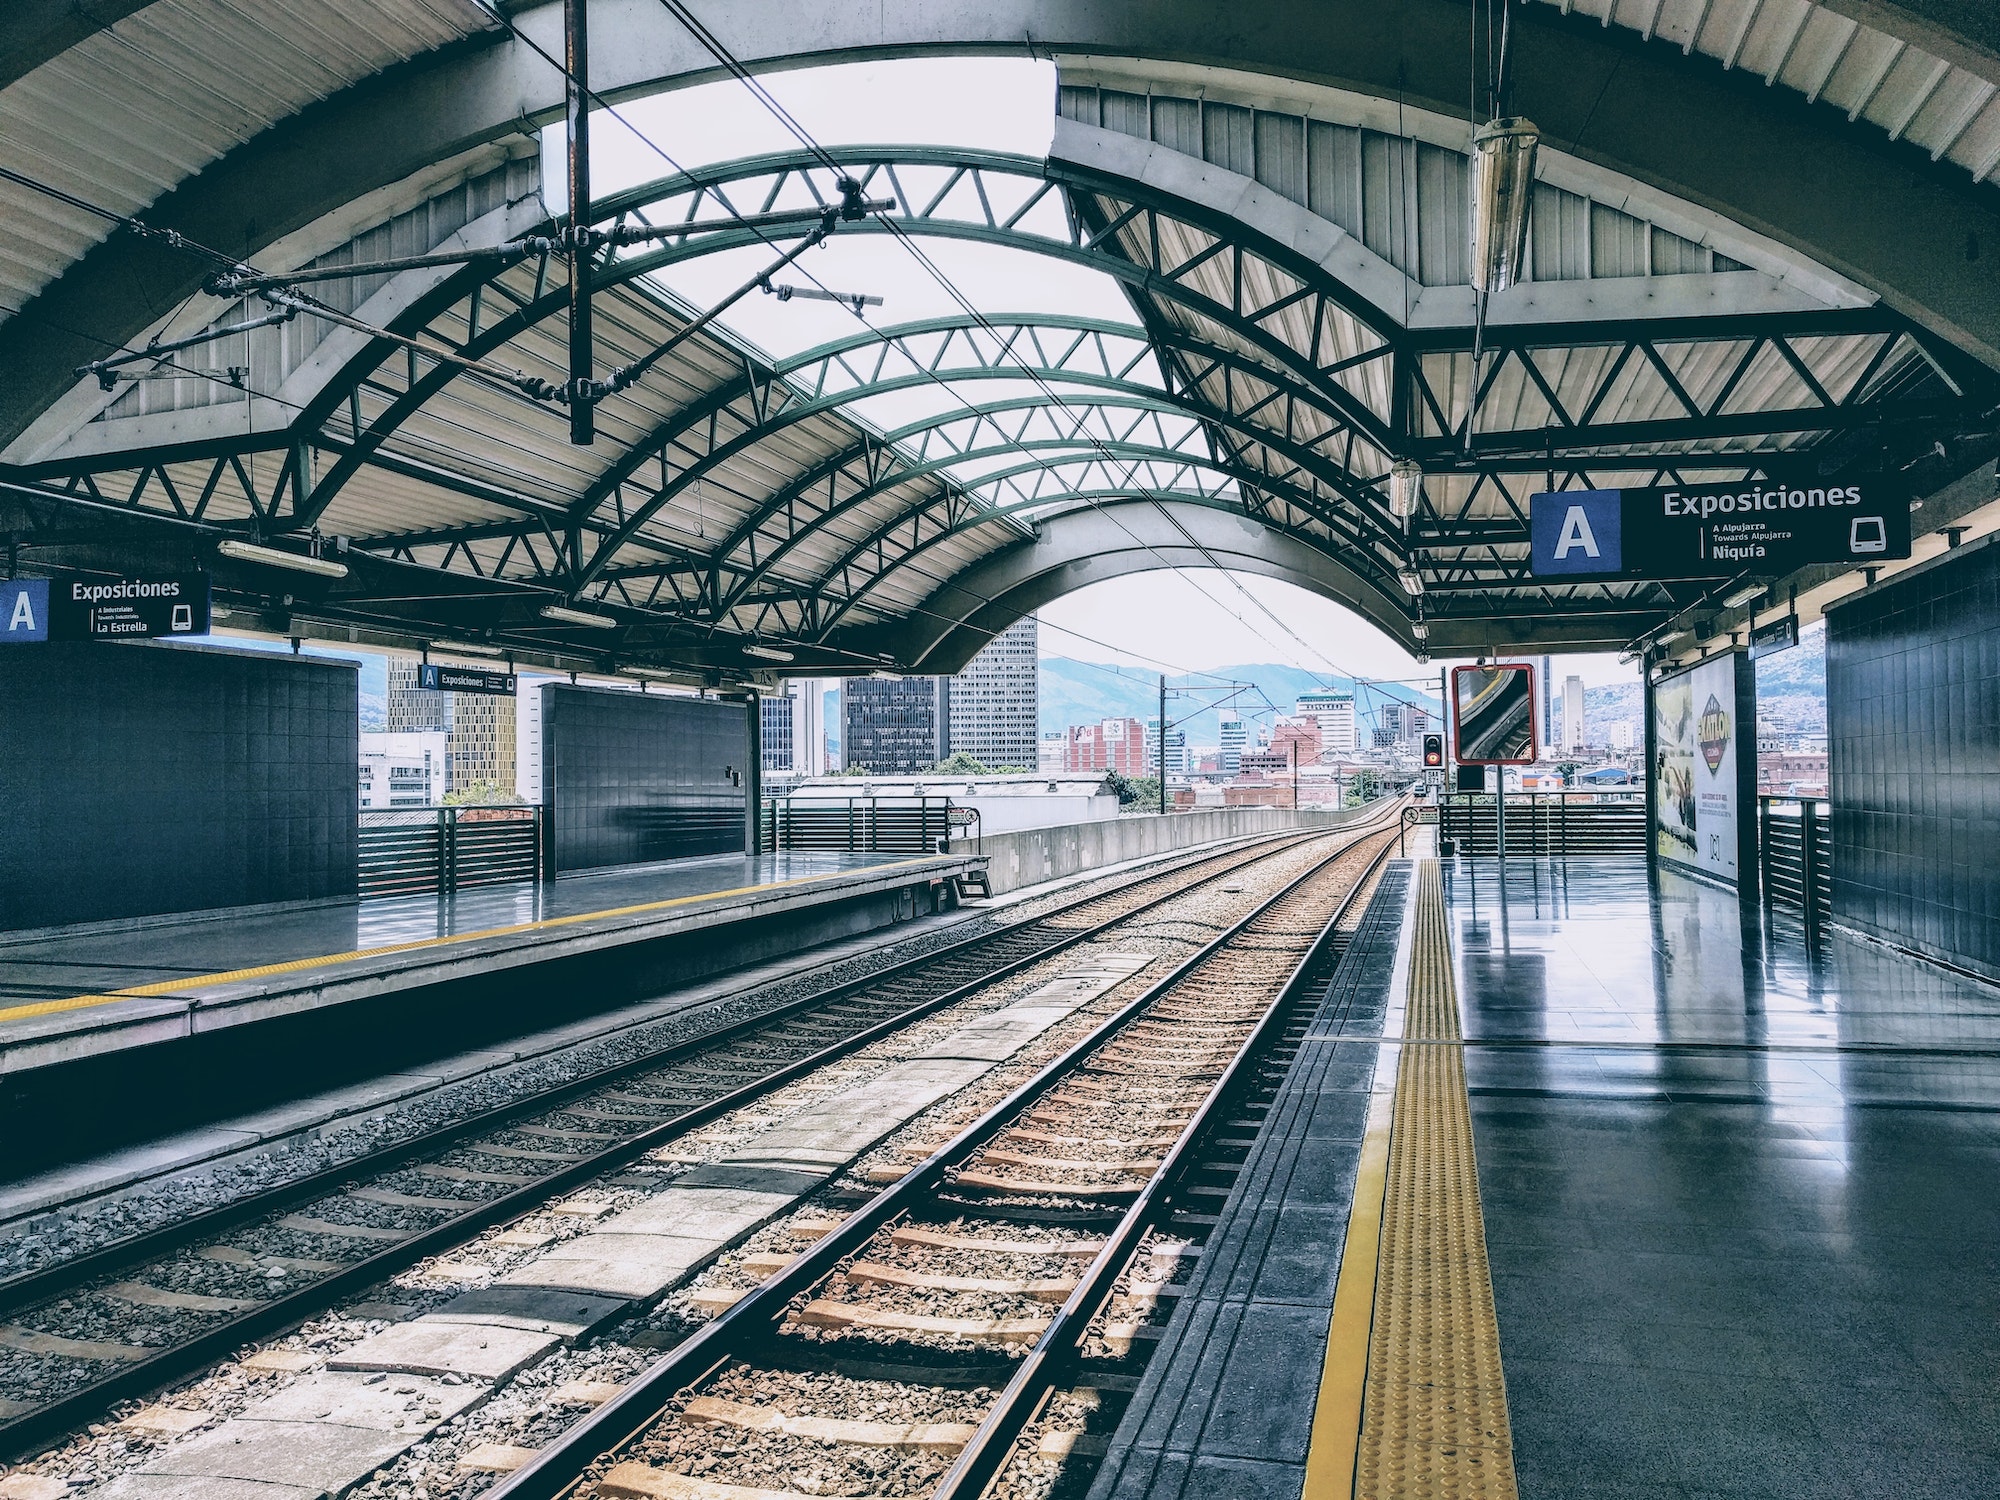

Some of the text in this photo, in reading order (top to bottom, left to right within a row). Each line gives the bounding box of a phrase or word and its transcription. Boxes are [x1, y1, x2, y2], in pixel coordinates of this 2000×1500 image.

[1664, 485, 1861, 518] Exposiciones
[1553, 505, 1600, 559] A
[1713, 531, 1792, 542] Towards Alpujarra
[1722, 523, 1766, 533] Alpujarra
[1713, 543, 1766, 561] Niquía
[73, 580, 179, 602] Exposiciones
[9, 591, 36, 631] A
[97, 622, 148, 633] La Estrella
[425, 669, 435, 686] A
[441, 674, 483, 687] Exposiciones
